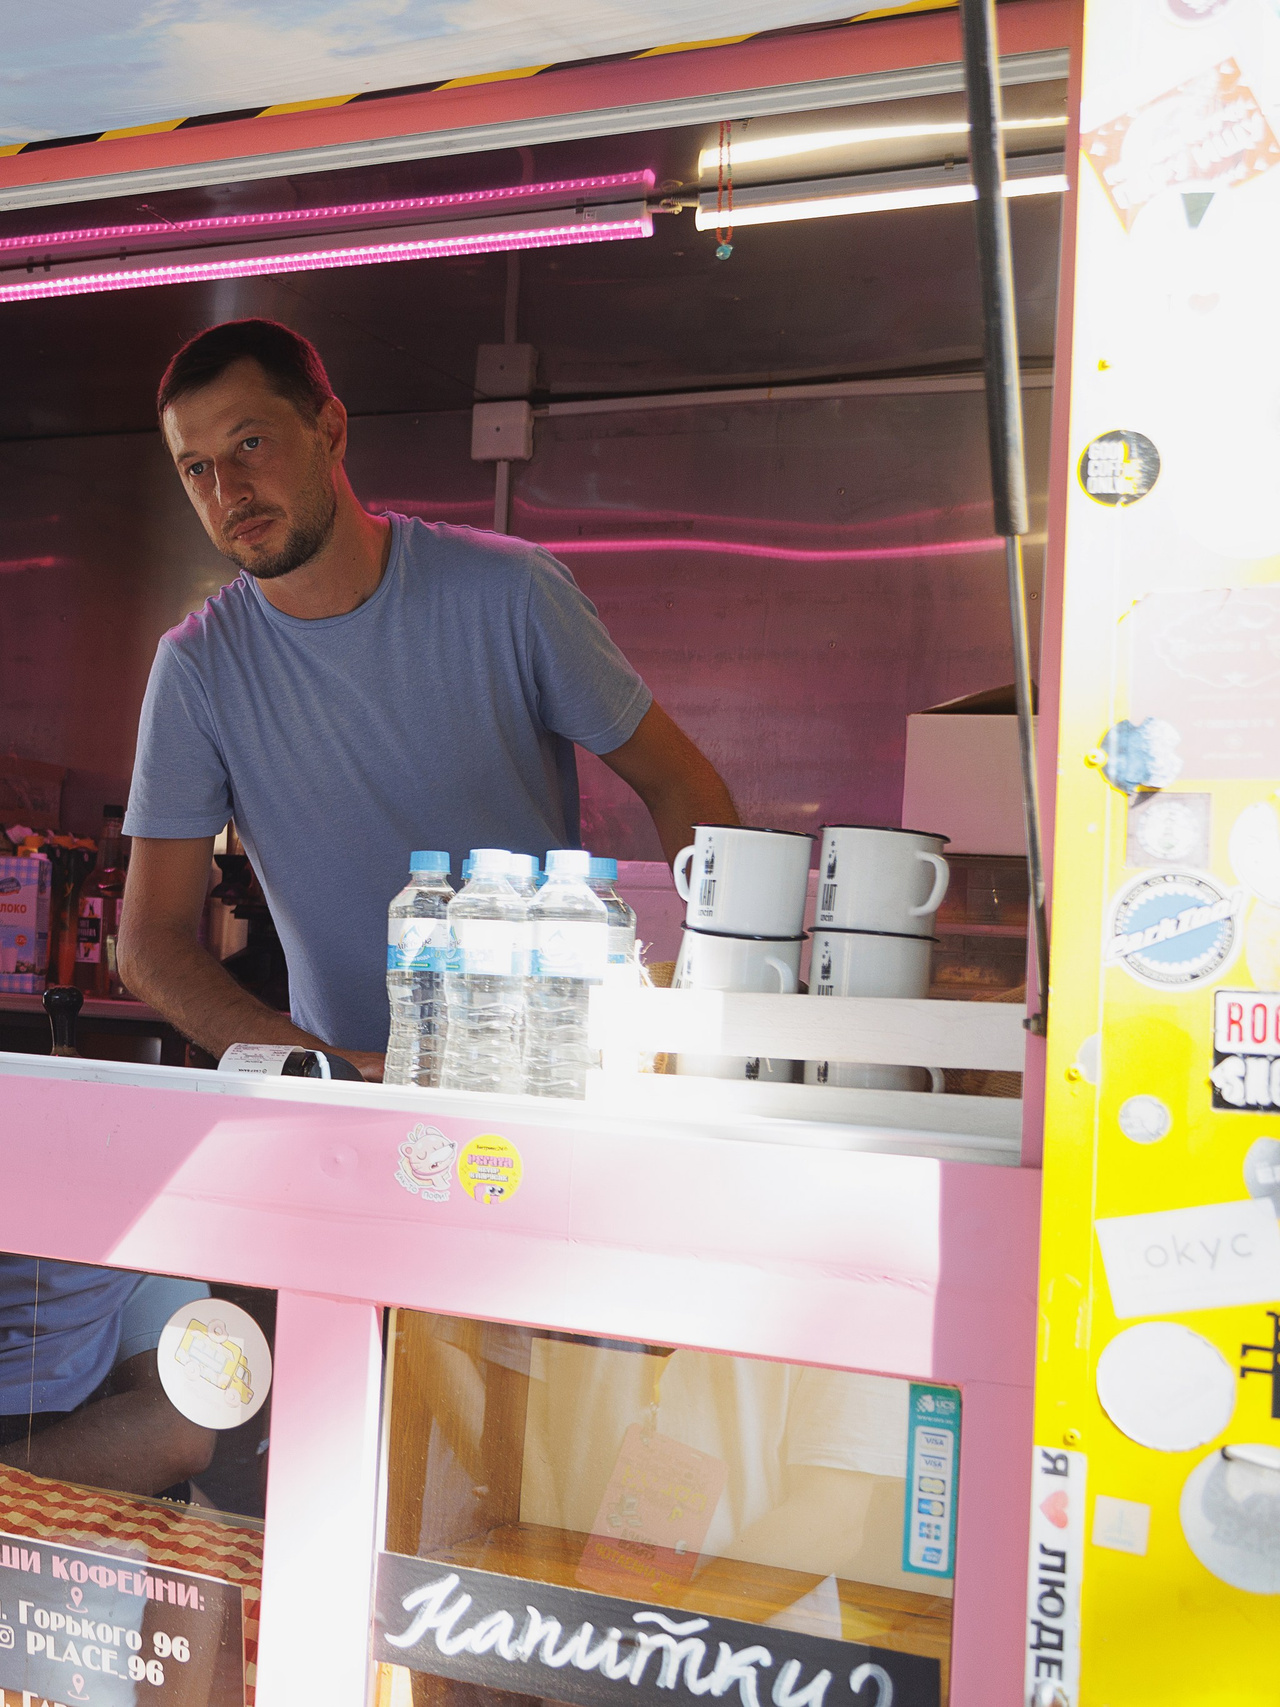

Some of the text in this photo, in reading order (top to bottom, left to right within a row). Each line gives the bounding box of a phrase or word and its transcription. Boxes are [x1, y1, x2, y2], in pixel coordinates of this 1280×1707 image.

[924, 1437, 945, 1446] VISA
[923, 1459, 943, 1469] VISA
[51, 1555, 205, 1612] КОФЕЙНИ:
[1029, 1449, 1069, 1690] Я ЛЮДЕ
[26, 1630, 165, 1687] PLACE_96
[153, 1631, 191, 1663] 96
